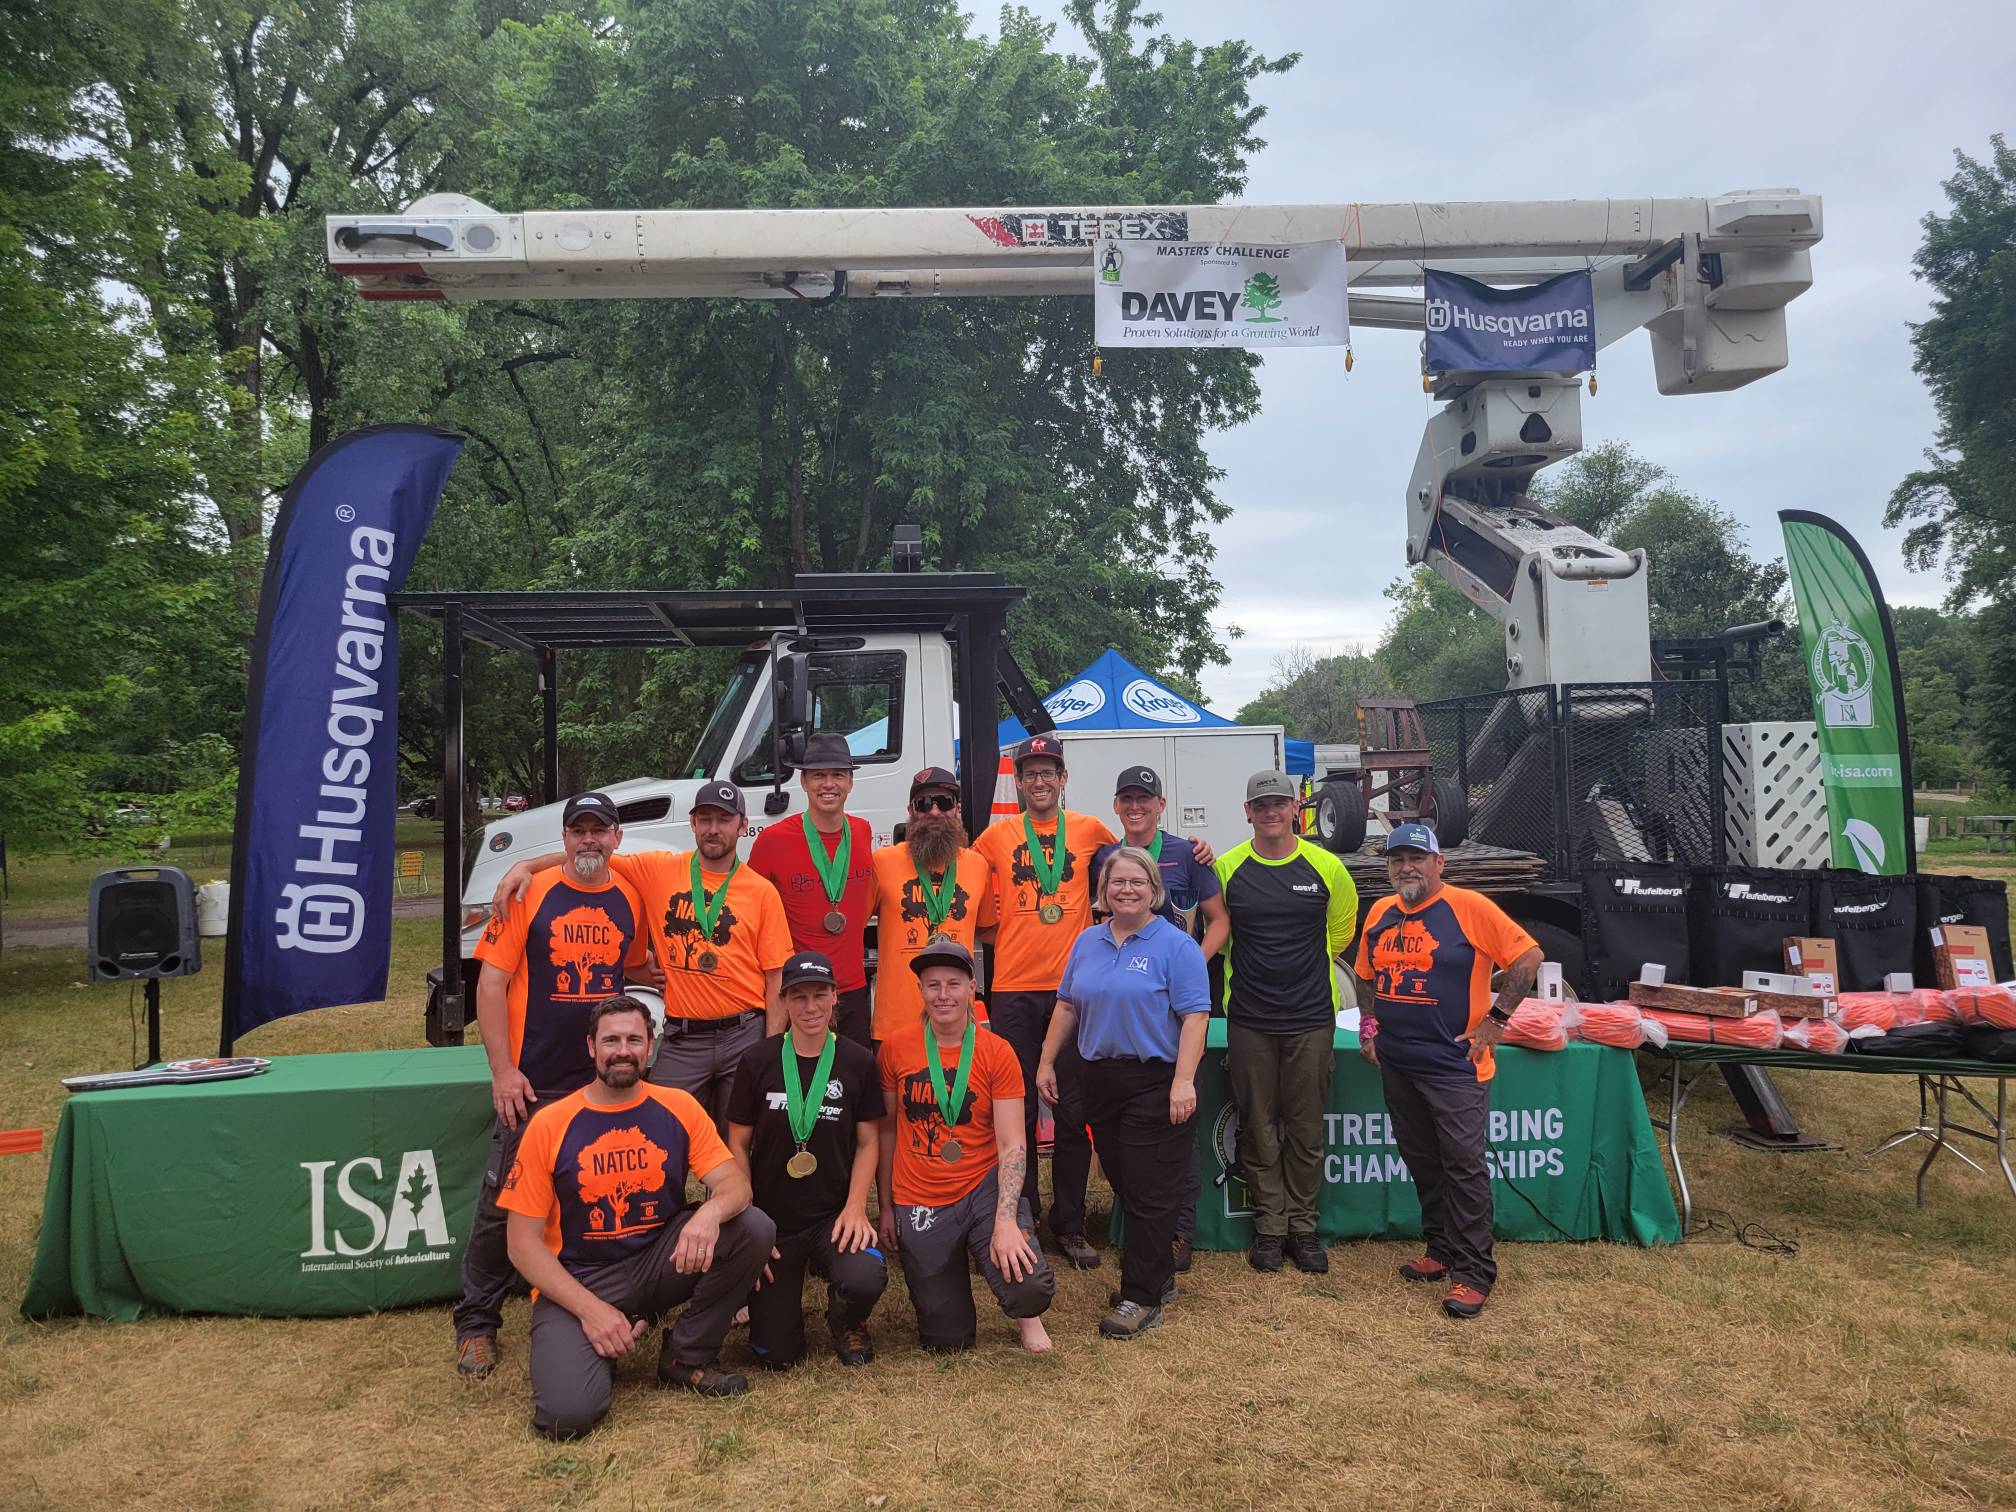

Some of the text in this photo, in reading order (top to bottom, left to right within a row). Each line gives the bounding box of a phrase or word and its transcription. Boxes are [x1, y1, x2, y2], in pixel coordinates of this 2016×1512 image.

[1058, 219, 1164, 240] TEREX
[1156, 245, 1290, 259] MASTERS' CHALLENGE
[1122, 291, 1242, 322] DAVEY
[1453, 305, 1588, 337] Husqvarna
[1123, 325, 1320, 341] Proven Solutions for a Growing World
[1503, 335, 1588, 348] READY WHEN YOU ARE
[295, 525, 395, 876] Husqvarna
[1840, 704, 1858, 722] ISA
[1632, 887, 1683, 897] Teufelberge
[564, 924, 610, 945] NATCC
[1382, 936, 1424, 953] NATCC
[593, 1147, 648, 1176] NATCC
[300, 1149, 450, 1257] ISA
[302, 1251, 450, 1272] International Society of Arboriculture
